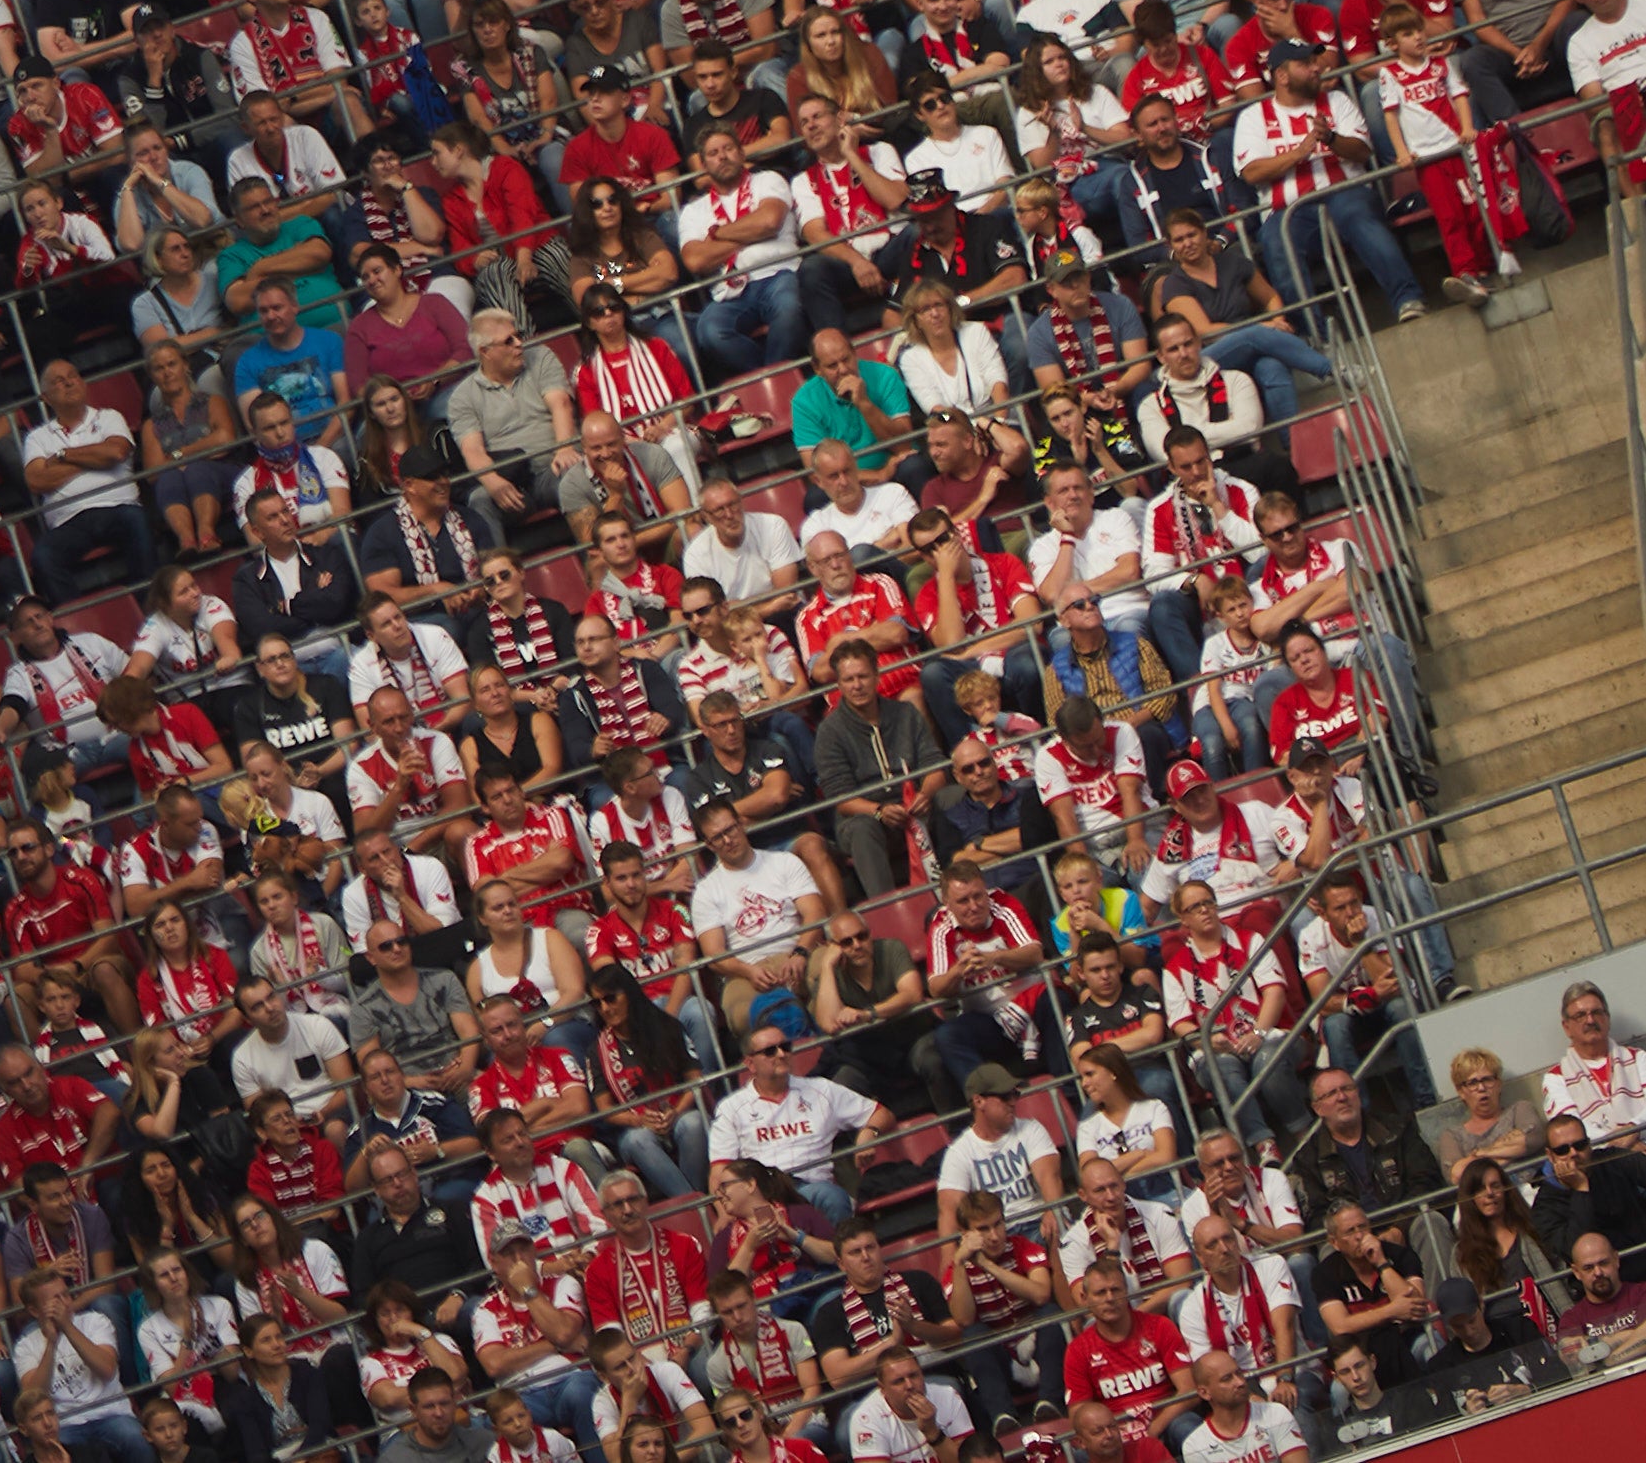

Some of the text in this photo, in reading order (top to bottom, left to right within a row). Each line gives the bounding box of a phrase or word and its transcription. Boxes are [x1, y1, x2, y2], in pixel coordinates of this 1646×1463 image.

[1169, 79, 1218, 108] EWE
[1404, 79, 1448, 106] REWE
[265, 718, 331, 750] REWE
[1295, 706, 1358, 740] REWE
[1072, 774, 1117, 806] REW
[623, 949, 674, 979] REW
[756, 1120, 812, 1144] REWE
[1101, 1361, 1168, 1399] REWE
